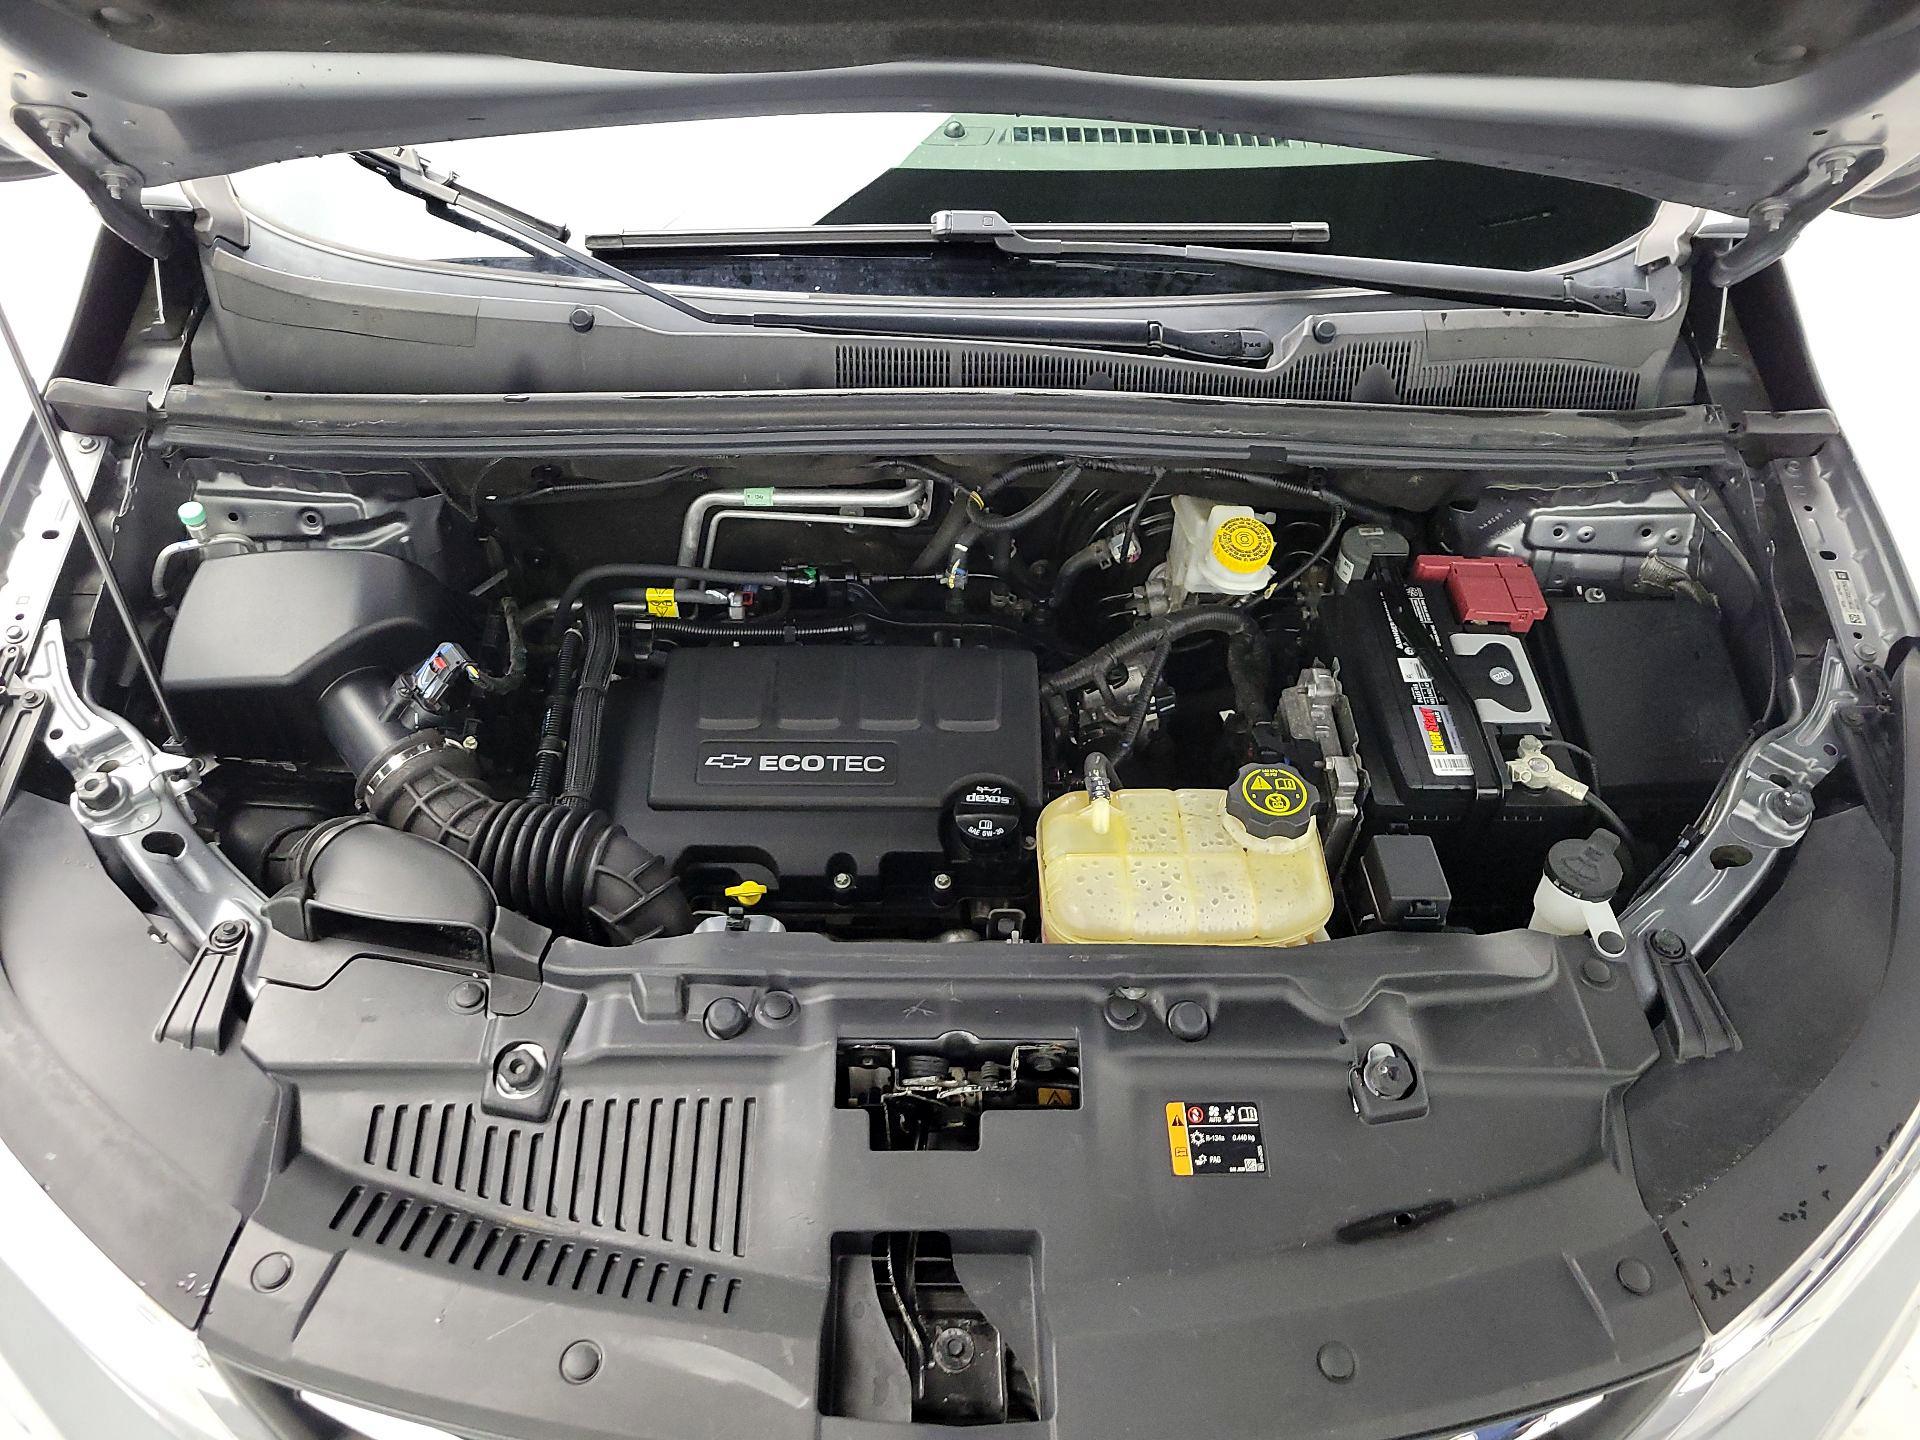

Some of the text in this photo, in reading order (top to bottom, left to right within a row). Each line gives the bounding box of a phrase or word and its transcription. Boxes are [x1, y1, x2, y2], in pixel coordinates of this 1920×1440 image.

[1419, 707, 1446, 752] EverStart
[759, 755, 886, 772] ECOTEC
[965, 792, 1012, 804] dexos
[967, 826, 1005, 837] SAE 5W-30
